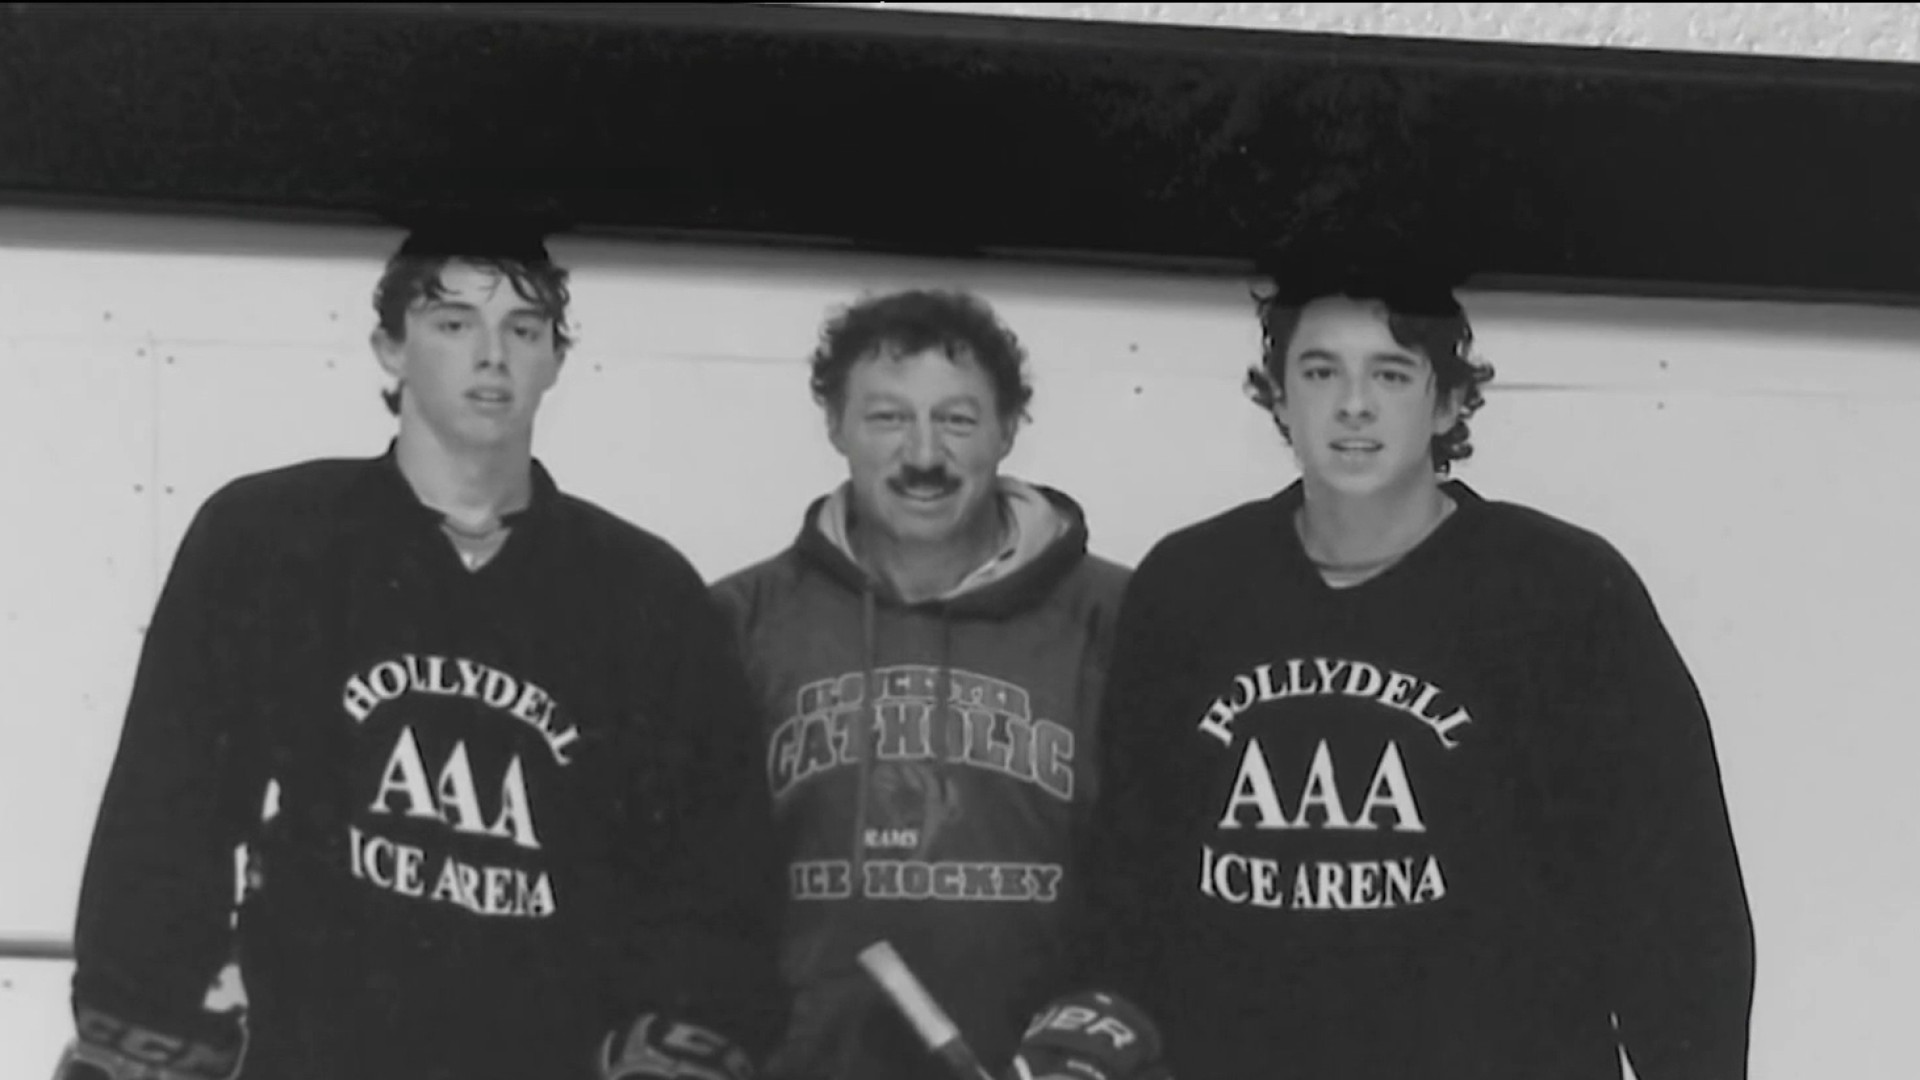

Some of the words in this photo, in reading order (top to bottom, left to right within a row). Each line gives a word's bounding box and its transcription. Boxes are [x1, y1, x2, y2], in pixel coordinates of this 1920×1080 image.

[343, 653, 580, 766] HOLLYDELL
[1198, 657, 1472, 750] HOLLYDELL
[369, 725, 542, 850] AAA
[768, 700, 1075, 801] CATHOLIC
[1217, 736, 1427, 833] AAA
[349, 825, 426, 898] ICE
[790, 861, 852, 900] ICE
[863, 860, 1063, 902] HOCKEY
[864, 828, 919, 849] RAMS
[1200, 845, 1284, 909] ICE
[1291, 855, 1447, 911] ARENA
